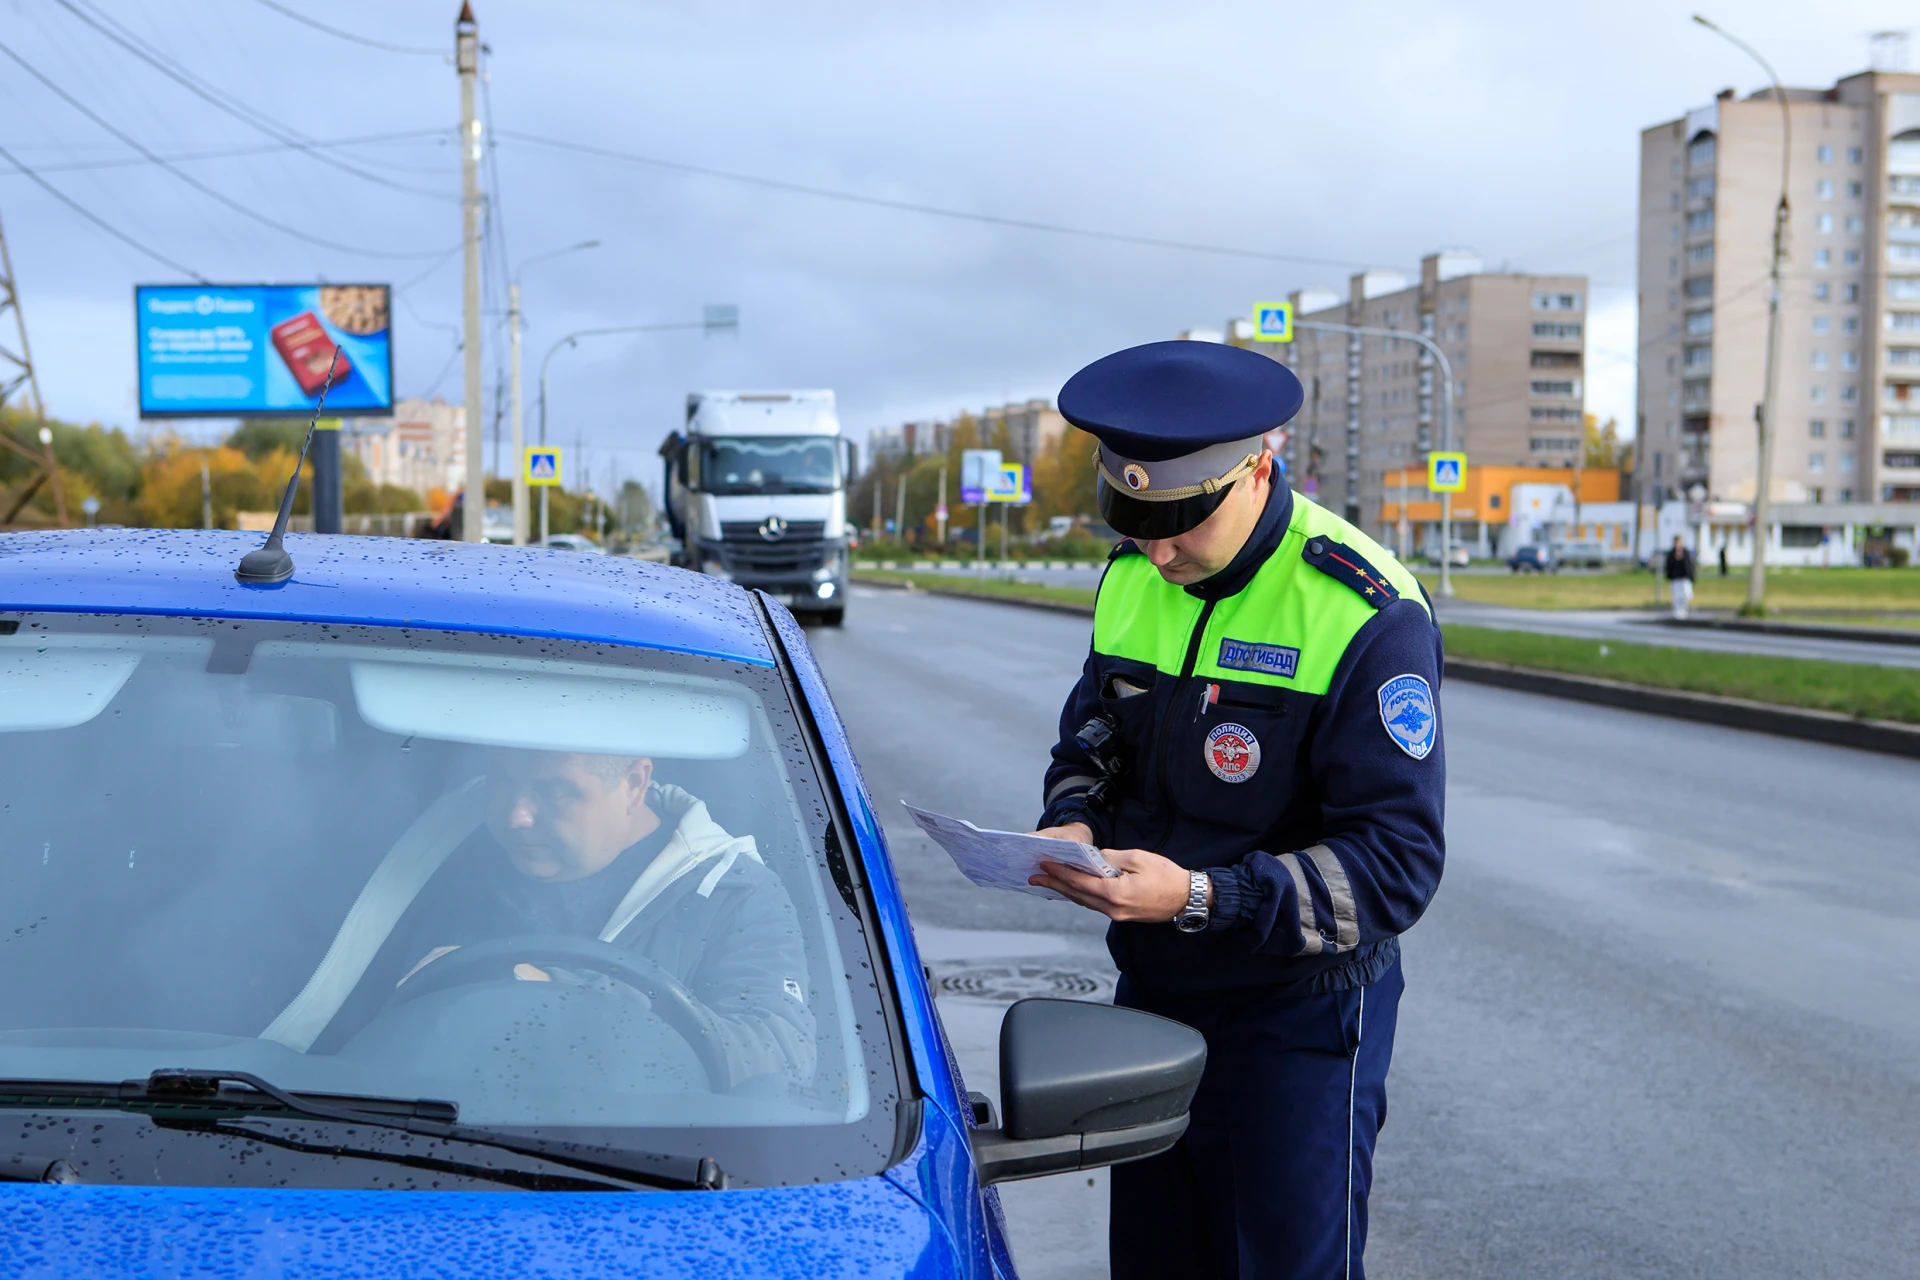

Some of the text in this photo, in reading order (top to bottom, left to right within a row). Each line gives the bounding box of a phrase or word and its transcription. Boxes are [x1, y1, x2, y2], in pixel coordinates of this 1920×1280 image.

[1224, 645, 1293, 671] ДПС ГИБДД
[1210, 724, 1254, 745] ПОЛИЦИЯ
[1408, 740, 1428, 756] МВД
[1221, 761, 1241, 772] ДПС
[1216, 771, 1247, 782] 53-0313
